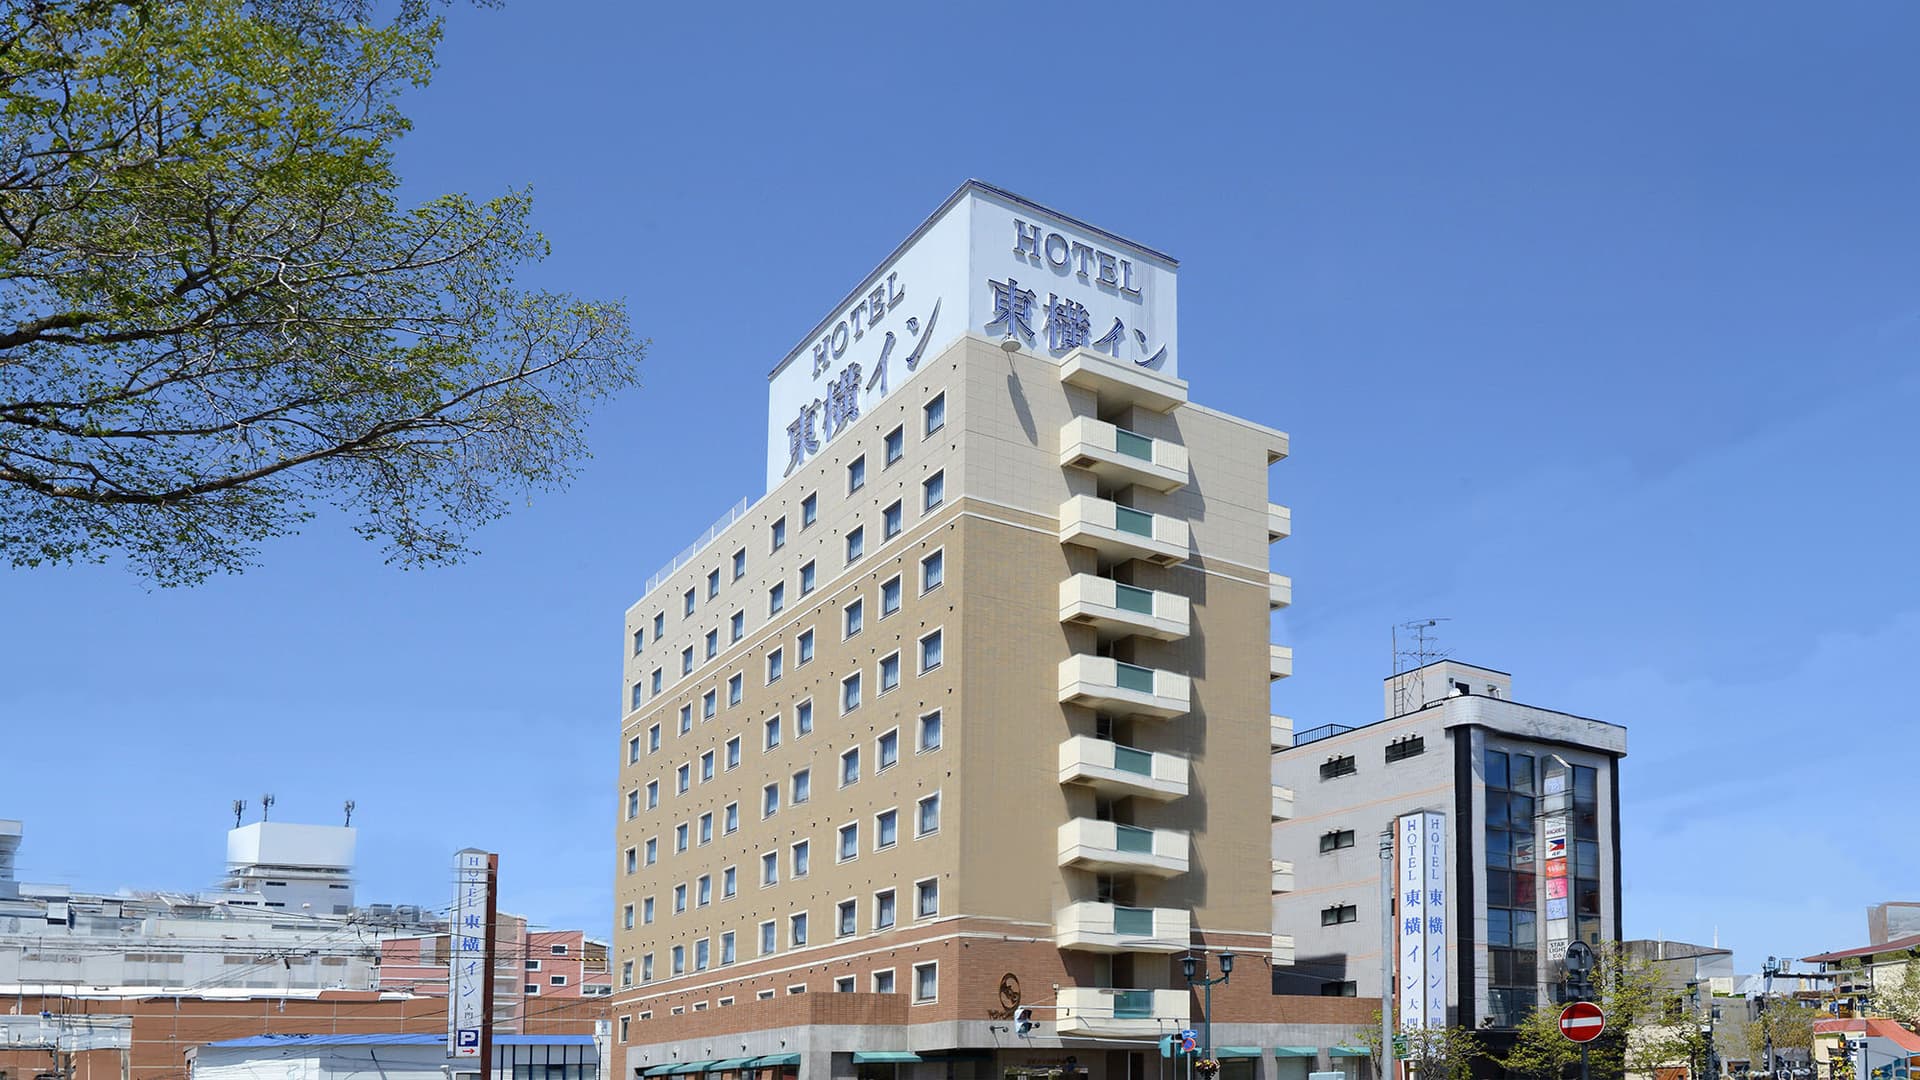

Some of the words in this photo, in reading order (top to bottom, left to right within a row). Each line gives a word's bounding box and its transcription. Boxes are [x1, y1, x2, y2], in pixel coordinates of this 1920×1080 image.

[1013, 218, 1142, 296] HOTEL
[812, 271, 906, 381] HOTEL
[984, 278, 1167, 369] 東横イン
[784, 296, 943, 478] 東横イン
[469, 857, 479, 907] HOTEL
[1407, 819, 1417, 881] HOTEL
[1431, 818, 1440, 880] HOTEL
